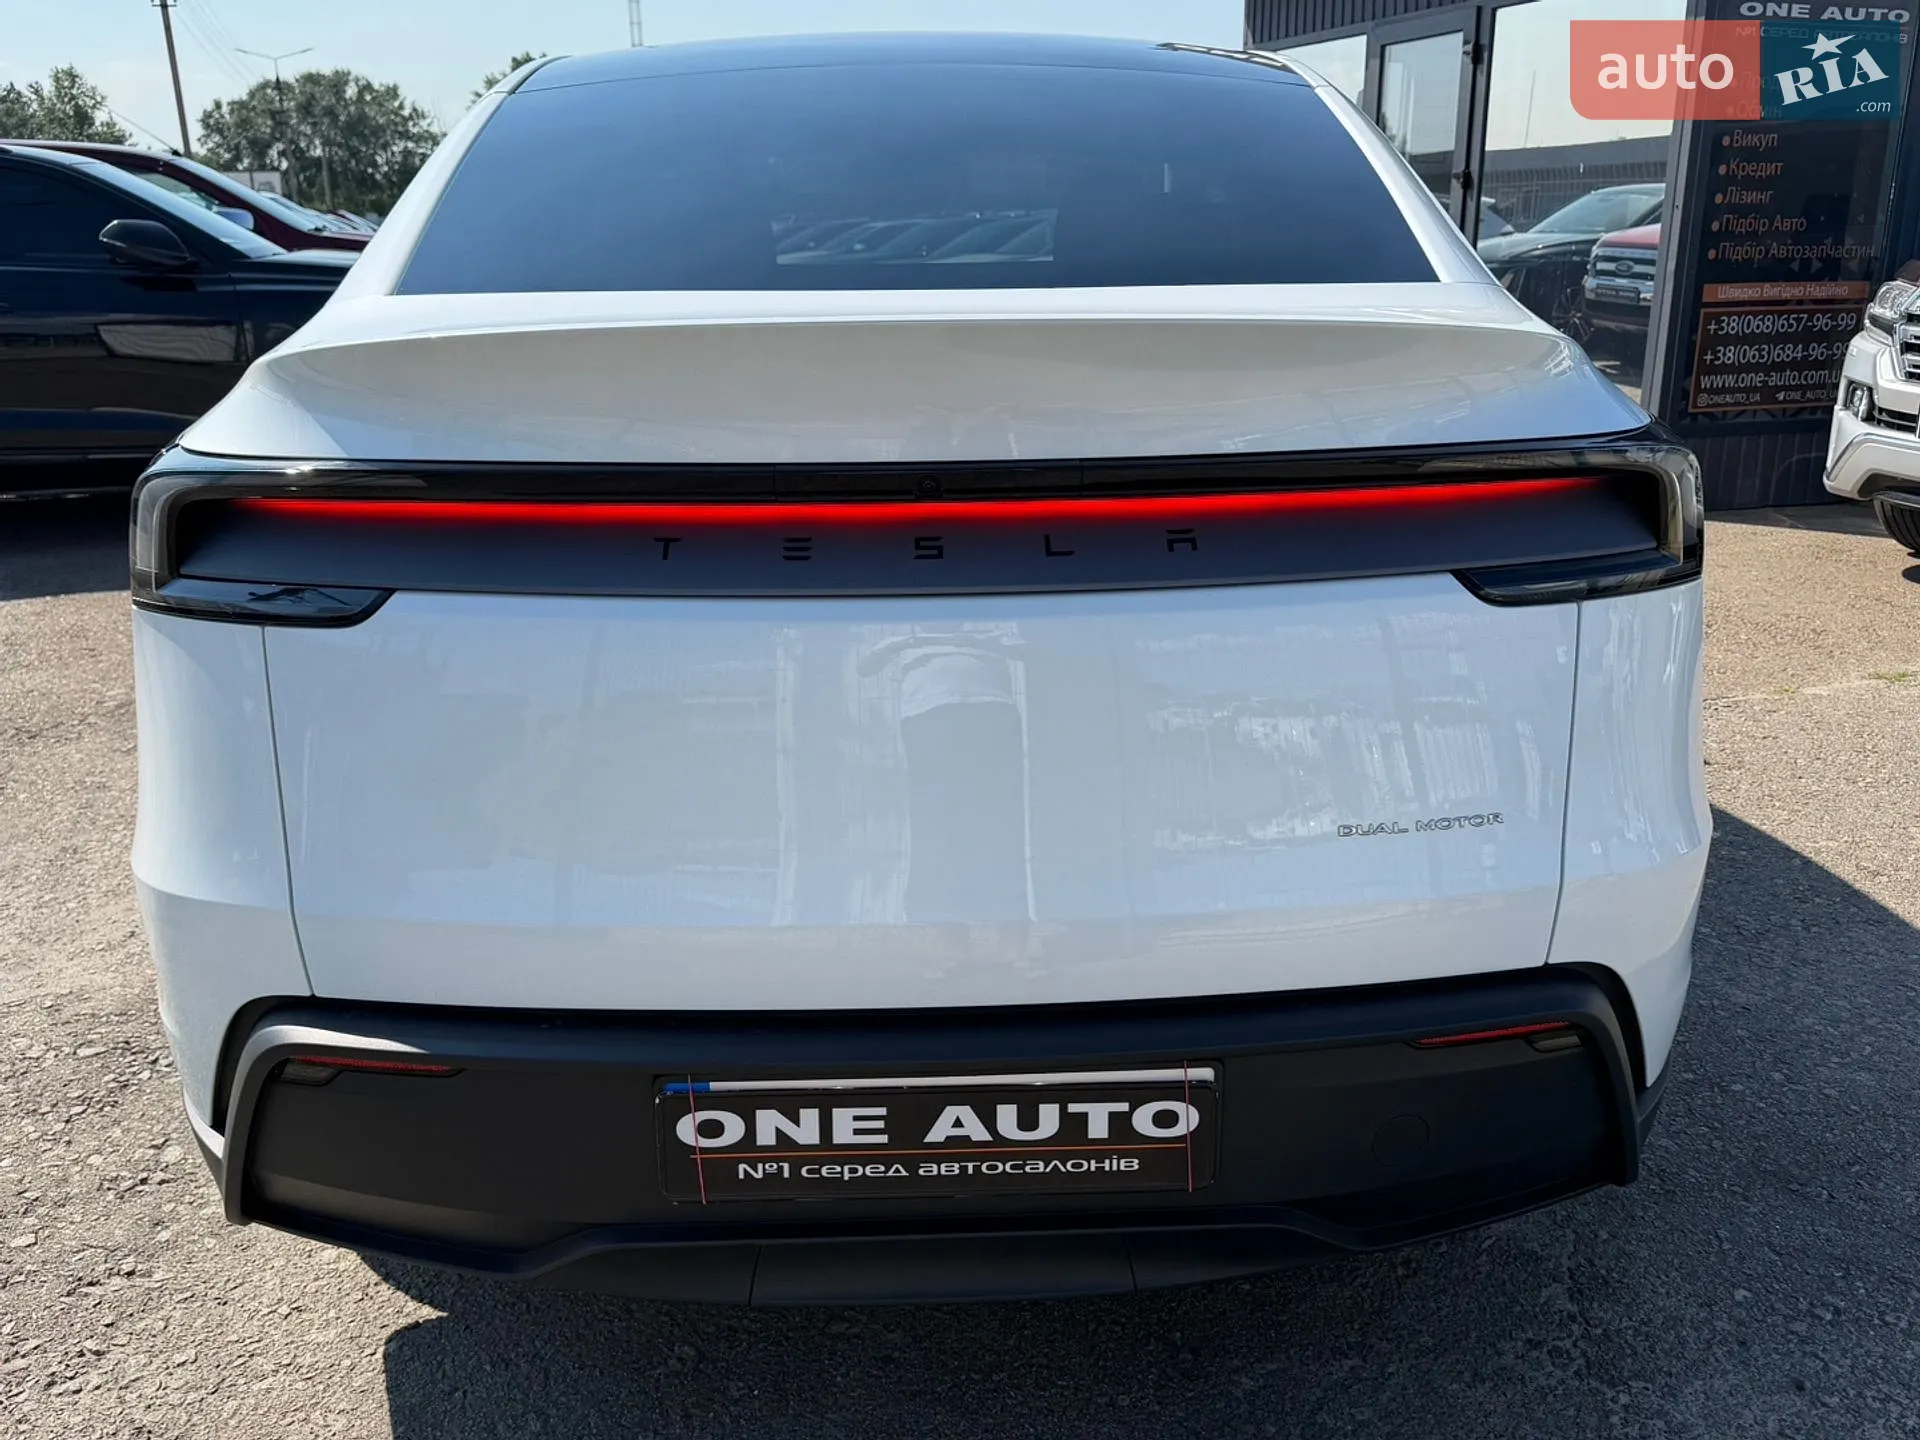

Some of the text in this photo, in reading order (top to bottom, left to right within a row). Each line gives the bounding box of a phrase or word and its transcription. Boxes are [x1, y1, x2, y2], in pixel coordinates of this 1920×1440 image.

[1740, 2, 1911, 23] ONE AUTO
[1732, 130, 1778, 151] Викуп
[1729, 159, 1784, 179] Кредит
[1724, 187, 1774, 204] Лізинг
[1722, 214, 1807, 235] Підбір Авто
[1718, 242, 1875, 262] Підбір Автозапчастин
[1718, 285, 1761, 299] Швидко
[1707, 313, 1857, 336] +38(068)657-96-99
[1700, 369, 1840, 389] www.one-auto.com.u
[653, 528, 1199, 561] TESLA
[1338, 812, 1504, 837] DUAL MOTOR
[676, 1100, 1200, 1148] ONE AUTO
[738, 1155, 1140, 1181] №1 серед автосалонів
